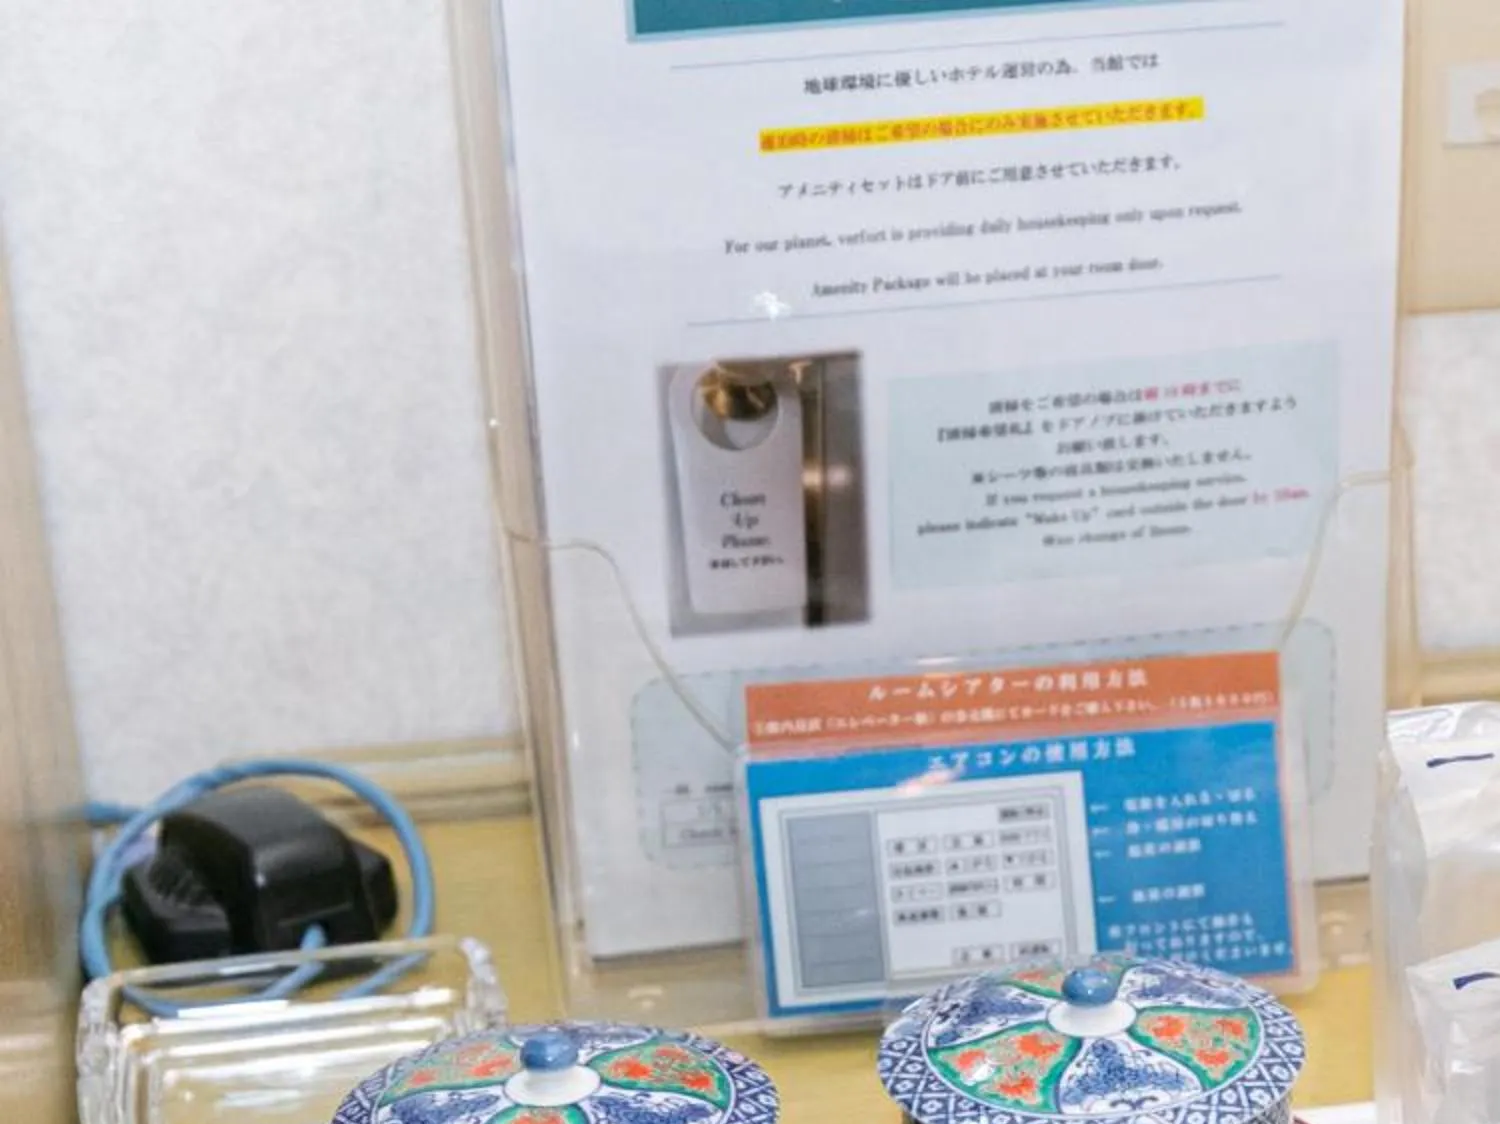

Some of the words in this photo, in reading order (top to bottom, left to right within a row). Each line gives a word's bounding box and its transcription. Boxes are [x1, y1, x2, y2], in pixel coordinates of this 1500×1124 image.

[724, 239, 749, 254] For
[908, 219, 974, 242] providing
[1017, 210, 1110, 233] housekeeping
[812, 279, 867, 297] Amenity
[872, 274, 930, 293] Package
[867, 668, 1148, 703] ルームシアターの利用方法
